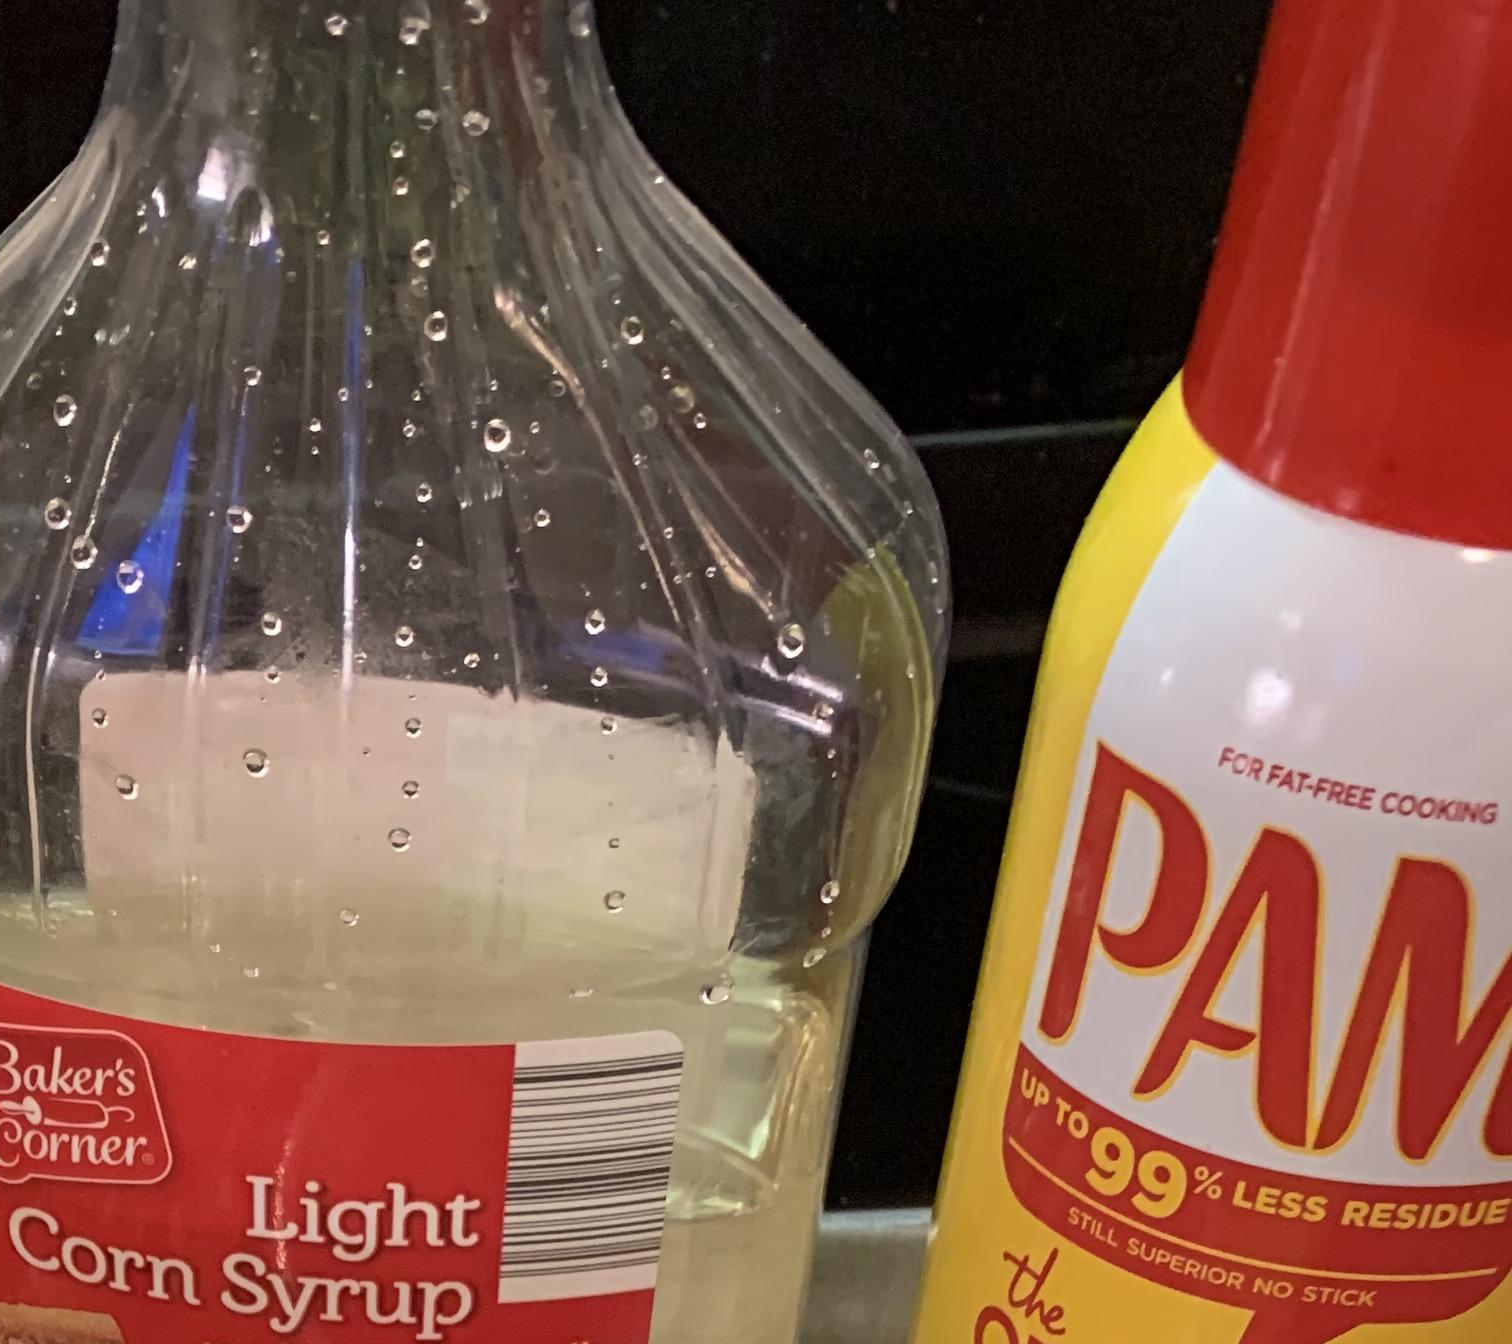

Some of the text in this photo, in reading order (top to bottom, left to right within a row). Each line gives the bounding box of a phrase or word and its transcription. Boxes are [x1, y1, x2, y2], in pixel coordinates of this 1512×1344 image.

[1218, 746, 1498, 825] FOR FAT-FREE COOKING
[1036, 738, 1512, 1166] PAM
[1020, 1068, 1050, 1108] UP
[1055, 1097, 1089, 1139] TO
[1232, 1180, 1328, 1222] LESS
[1341, 1197, 1511, 1230] RESIDUE
[246, 1176, 480, 1262] Light
[1067, 1207, 1377, 1308] STILL SUPERIOR NO STICK
[9, 1208, 473, 1341] Corn Syrup
[1003, 1246, 1066, 1336] the
